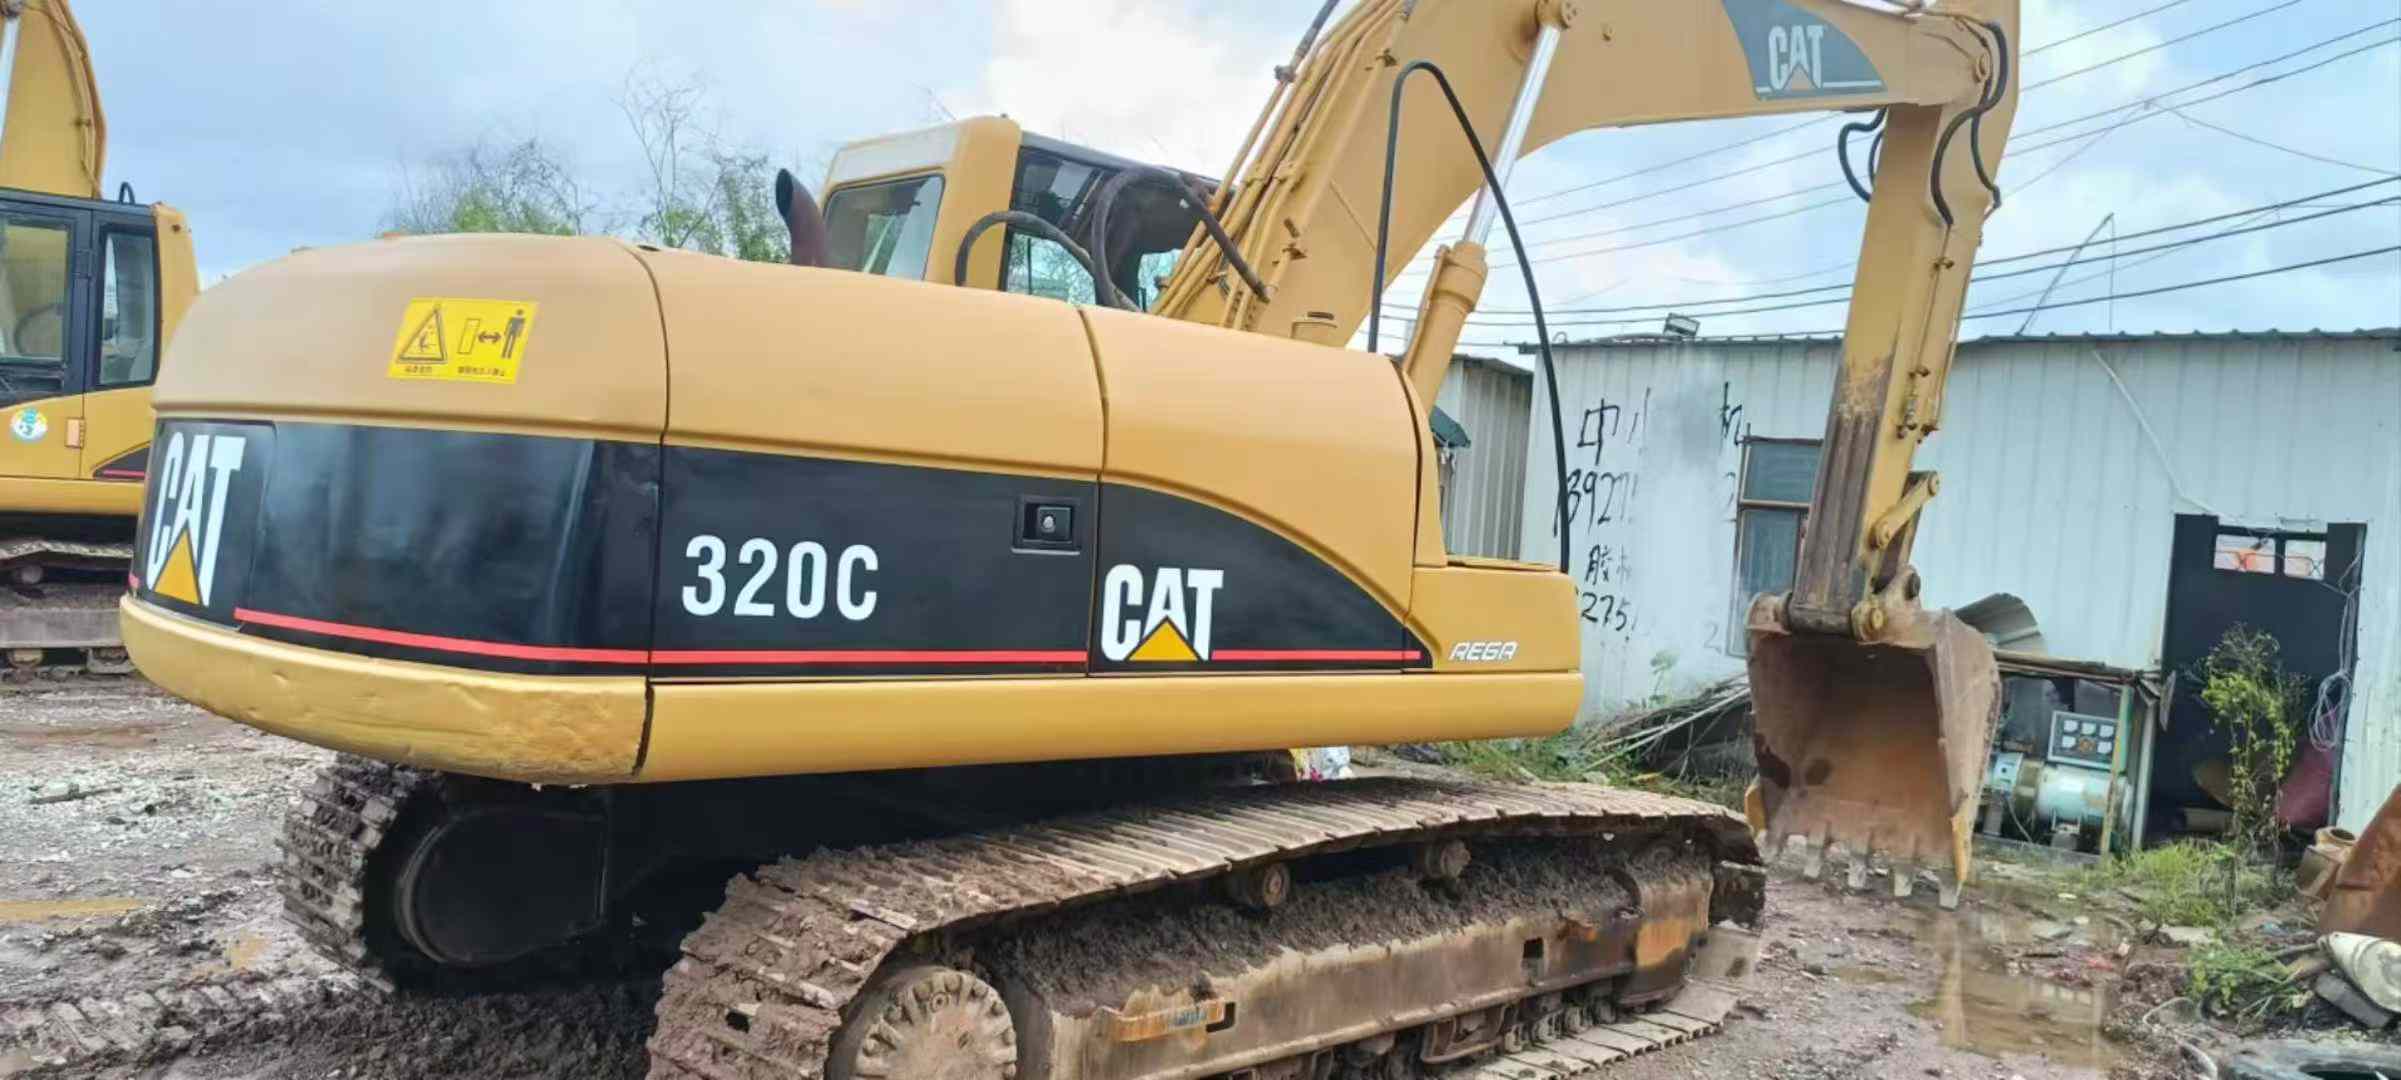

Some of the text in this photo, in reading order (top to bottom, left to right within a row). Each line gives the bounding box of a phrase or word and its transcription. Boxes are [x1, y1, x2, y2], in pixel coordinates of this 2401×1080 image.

[1768, 25, 1825, 90] CAT
[146, 432, 246, 607] CAT
[682, 535, 878, 620] 320C
[1101, 564, 1224, 661] CAT
[1576, 586, 1631, 631] 275
